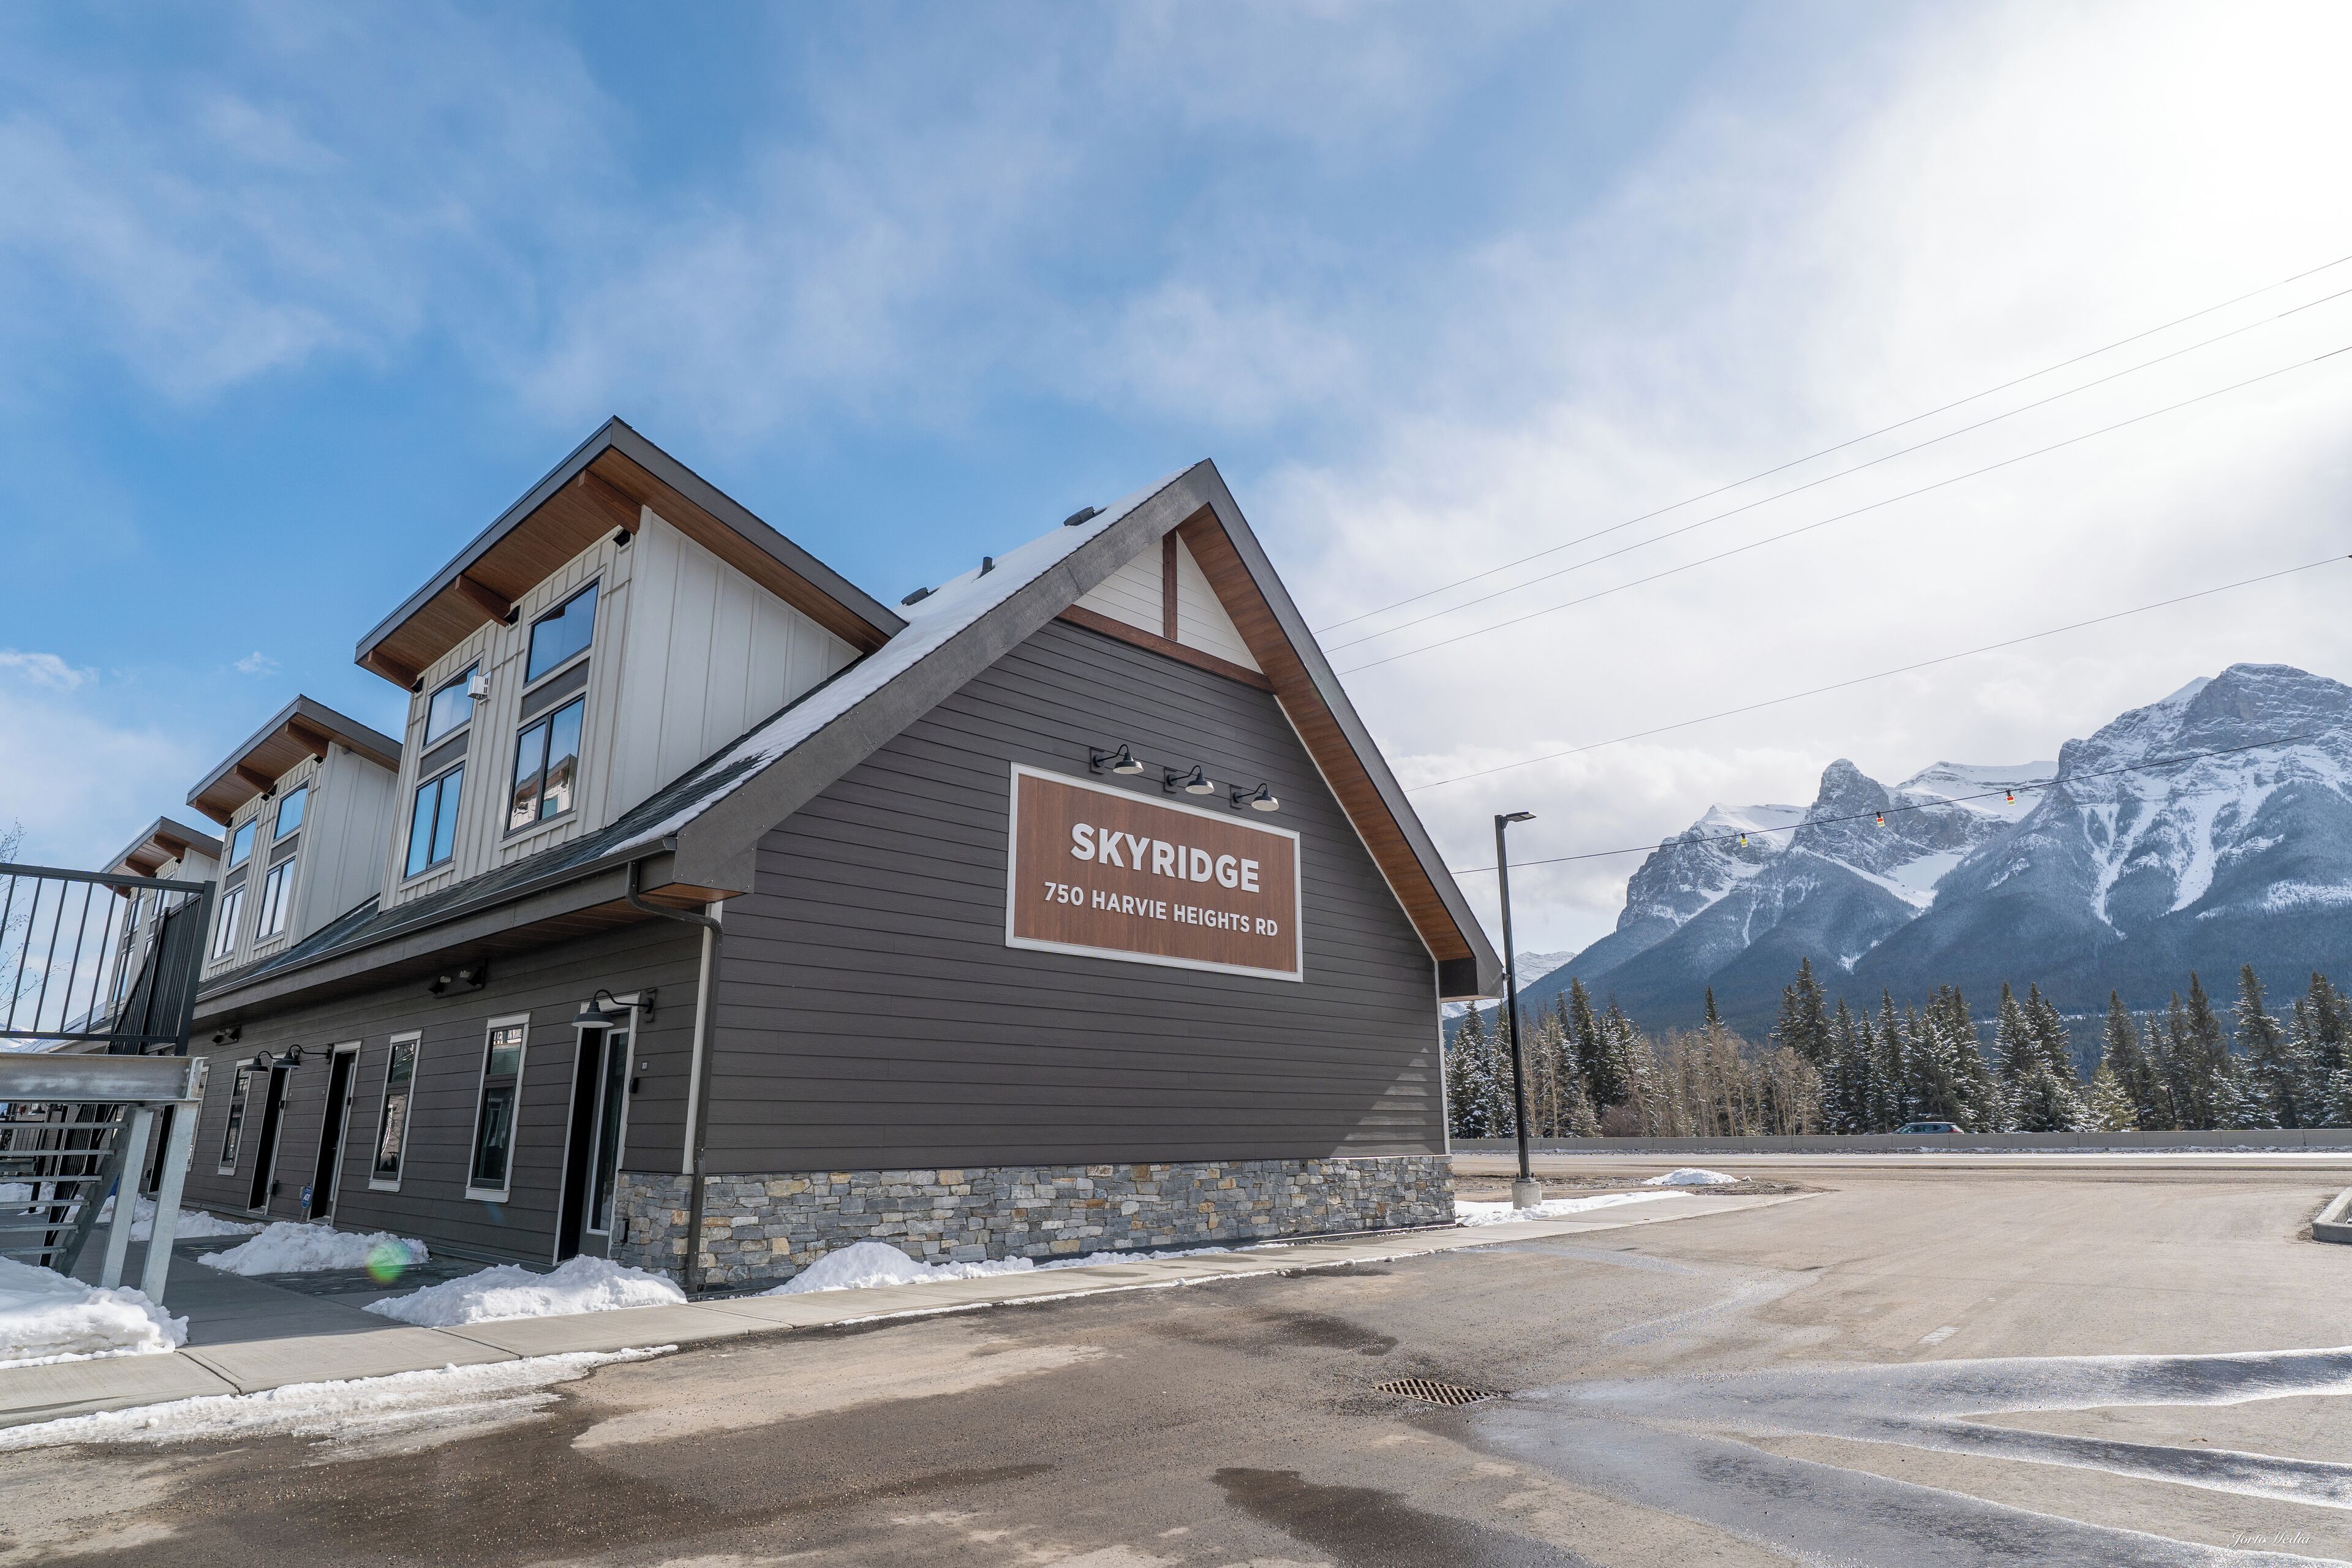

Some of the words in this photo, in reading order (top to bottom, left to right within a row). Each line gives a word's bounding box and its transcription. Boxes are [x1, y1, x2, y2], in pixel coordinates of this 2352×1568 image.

[1071, 823, 1259, 893] SKYRIDGE
[1044, 881, 1084, 906] 750
[1092, 890, 1167, 920] HARVIE
[1174, 904, 1250, 933] HEIGHTS
[1256, 918, 1278, 937] RD
